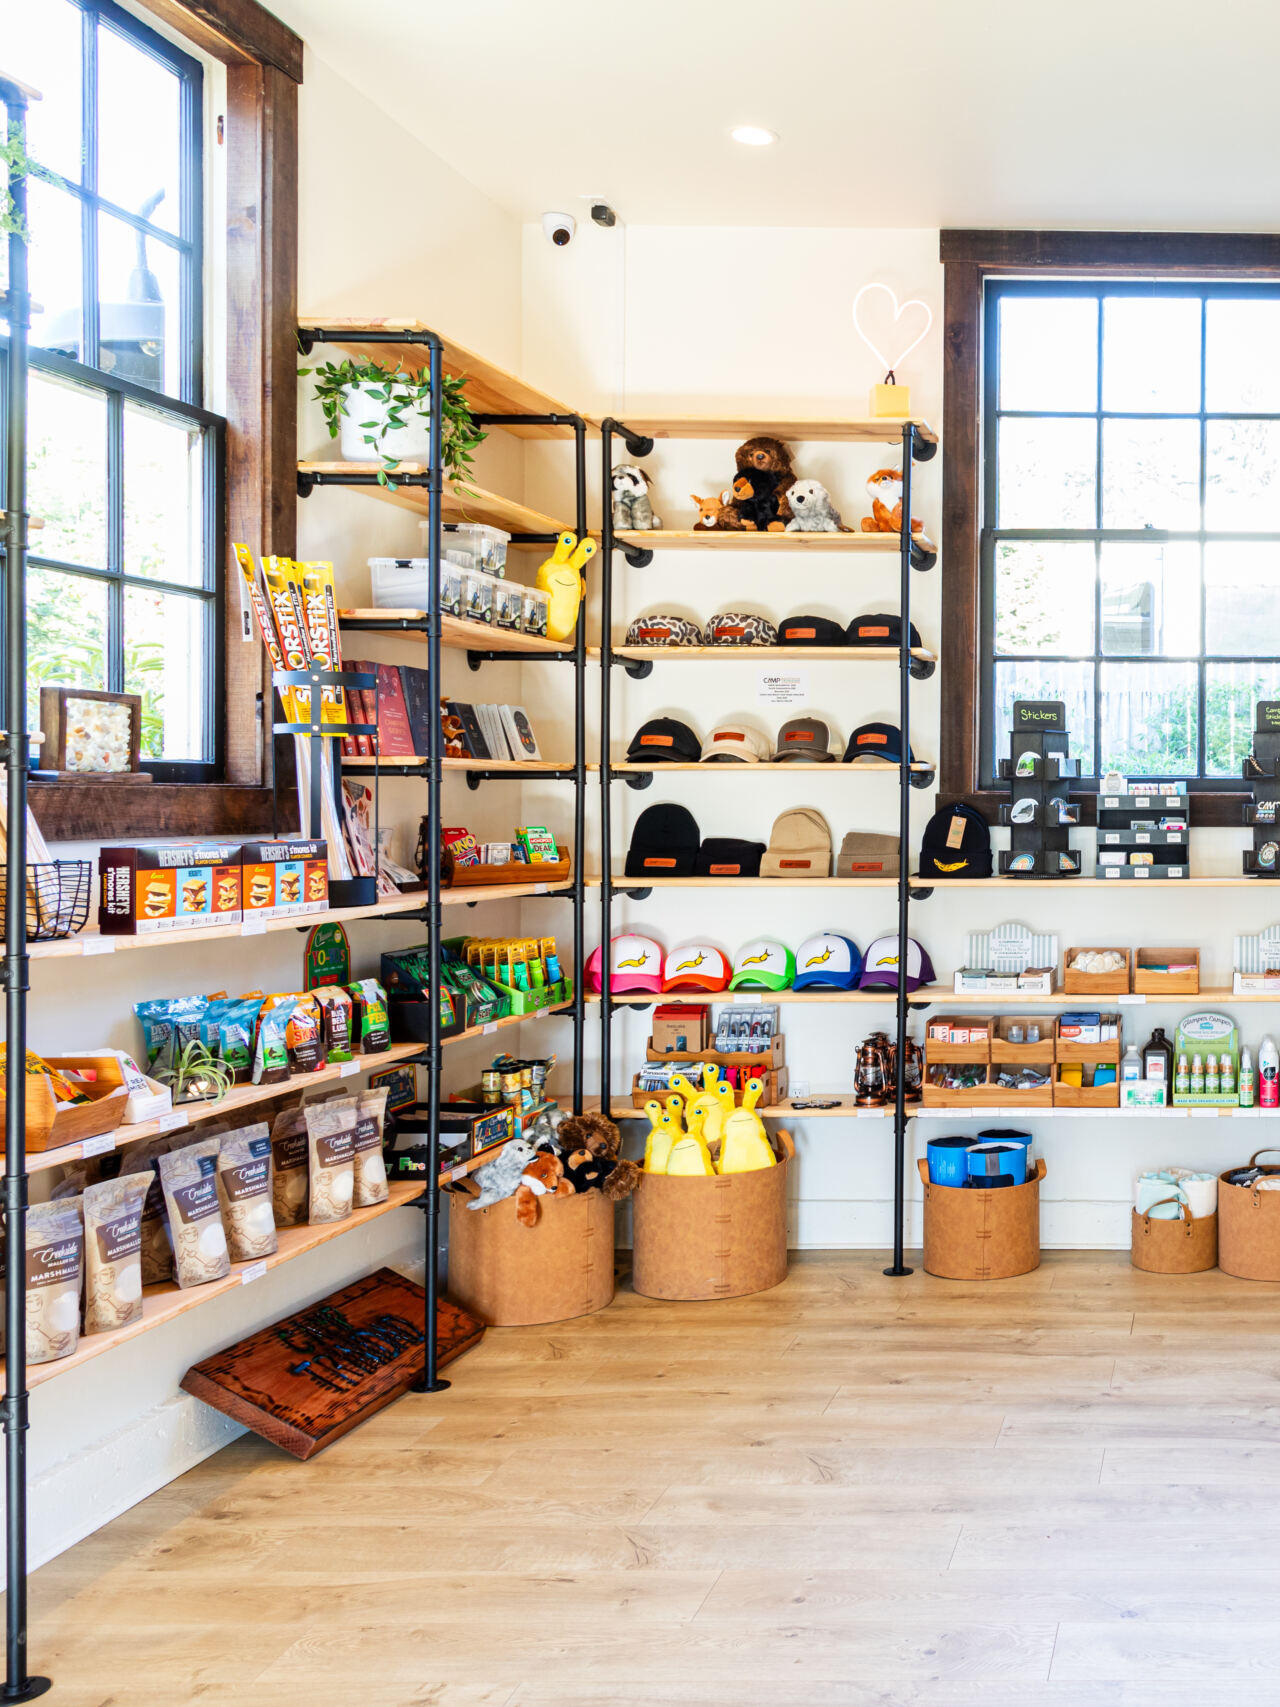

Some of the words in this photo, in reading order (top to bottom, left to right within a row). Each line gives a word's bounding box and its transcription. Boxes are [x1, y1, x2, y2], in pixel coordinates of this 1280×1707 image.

[1020, 709, 1058, 721] Stickers
[260, 845, 290, 862] HERSHEY'S
[289, 845, 311, 855] s'mores
[309, 843, 318, 853] kit
[447, 834, 476, 856] UNO
[533, 844, 553, 852] DEAL
[158, 849, 195, 867] HERSHEY'S
[194, 849, 219, 860] s'mores
[219, 847, 229, 859] kit
[107, 867, 116, 901] s'mores
[116, 866, 130, 915] HERSHEY'S
[107, 902, 116, 914] kit
[232, 1163, 267, 1180] Creekside
[399, 1157, 426, 1171] Fire
[182, 1183, 214, 1201] Creekside
[105, 1217, 140, 1239] Creekside
[32, 1241, 79, 1264] Creekside
